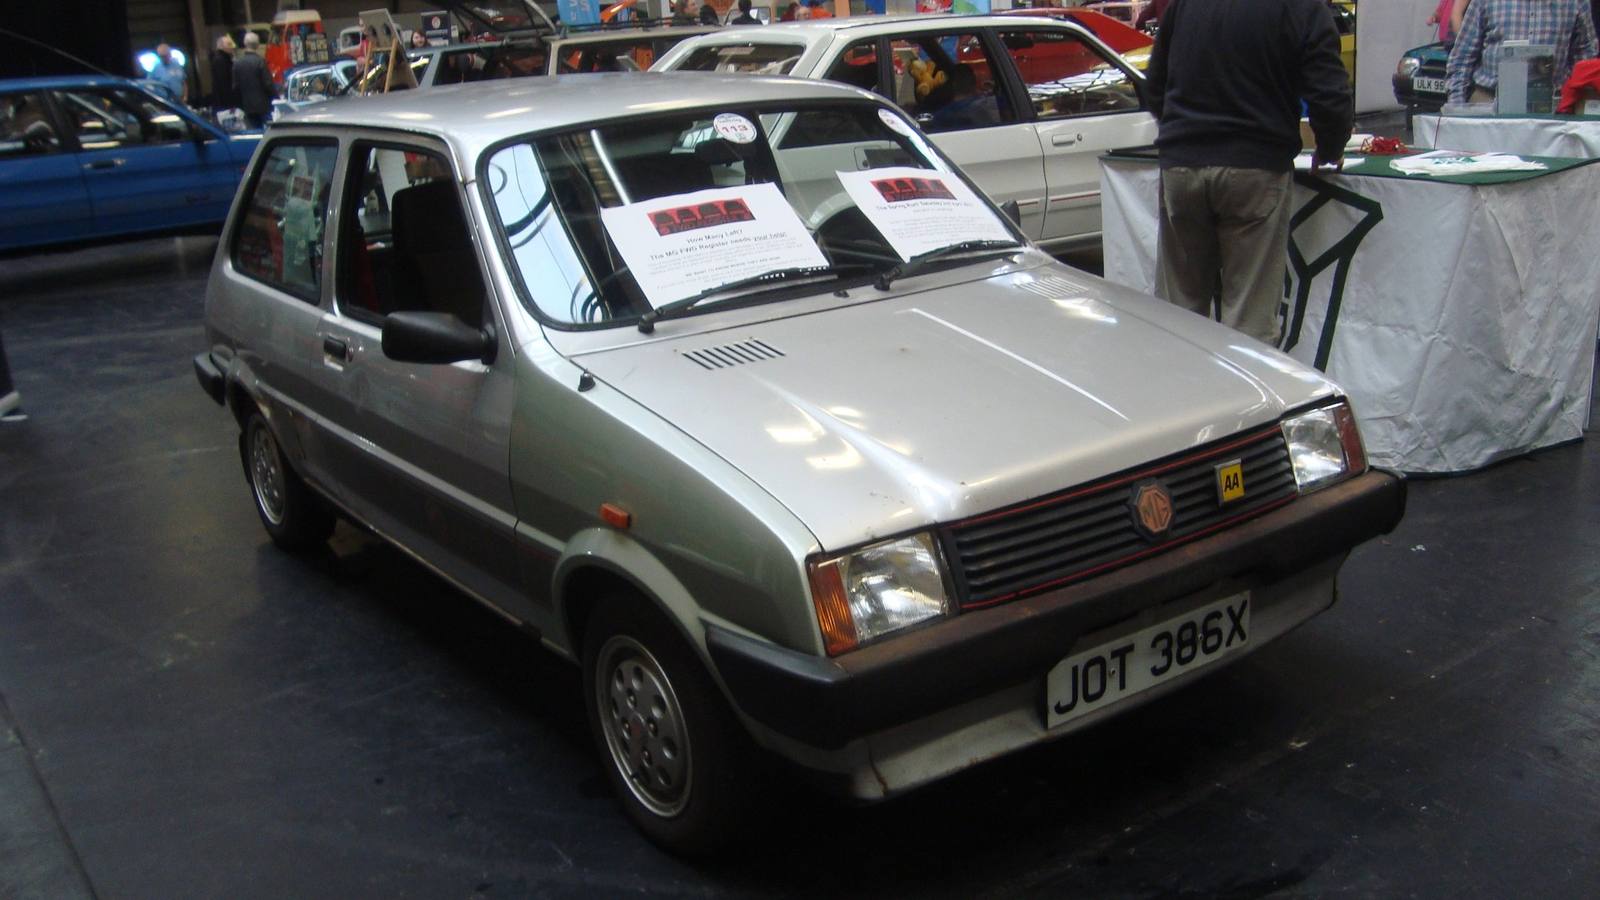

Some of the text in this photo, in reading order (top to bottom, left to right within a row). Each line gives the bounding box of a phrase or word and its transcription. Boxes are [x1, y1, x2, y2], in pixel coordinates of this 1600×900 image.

[1223, 472, 1240, 493] AA
[1138, 487, 1172, 531] MG
[1054, 600, 1248, 714] JOT 386X
